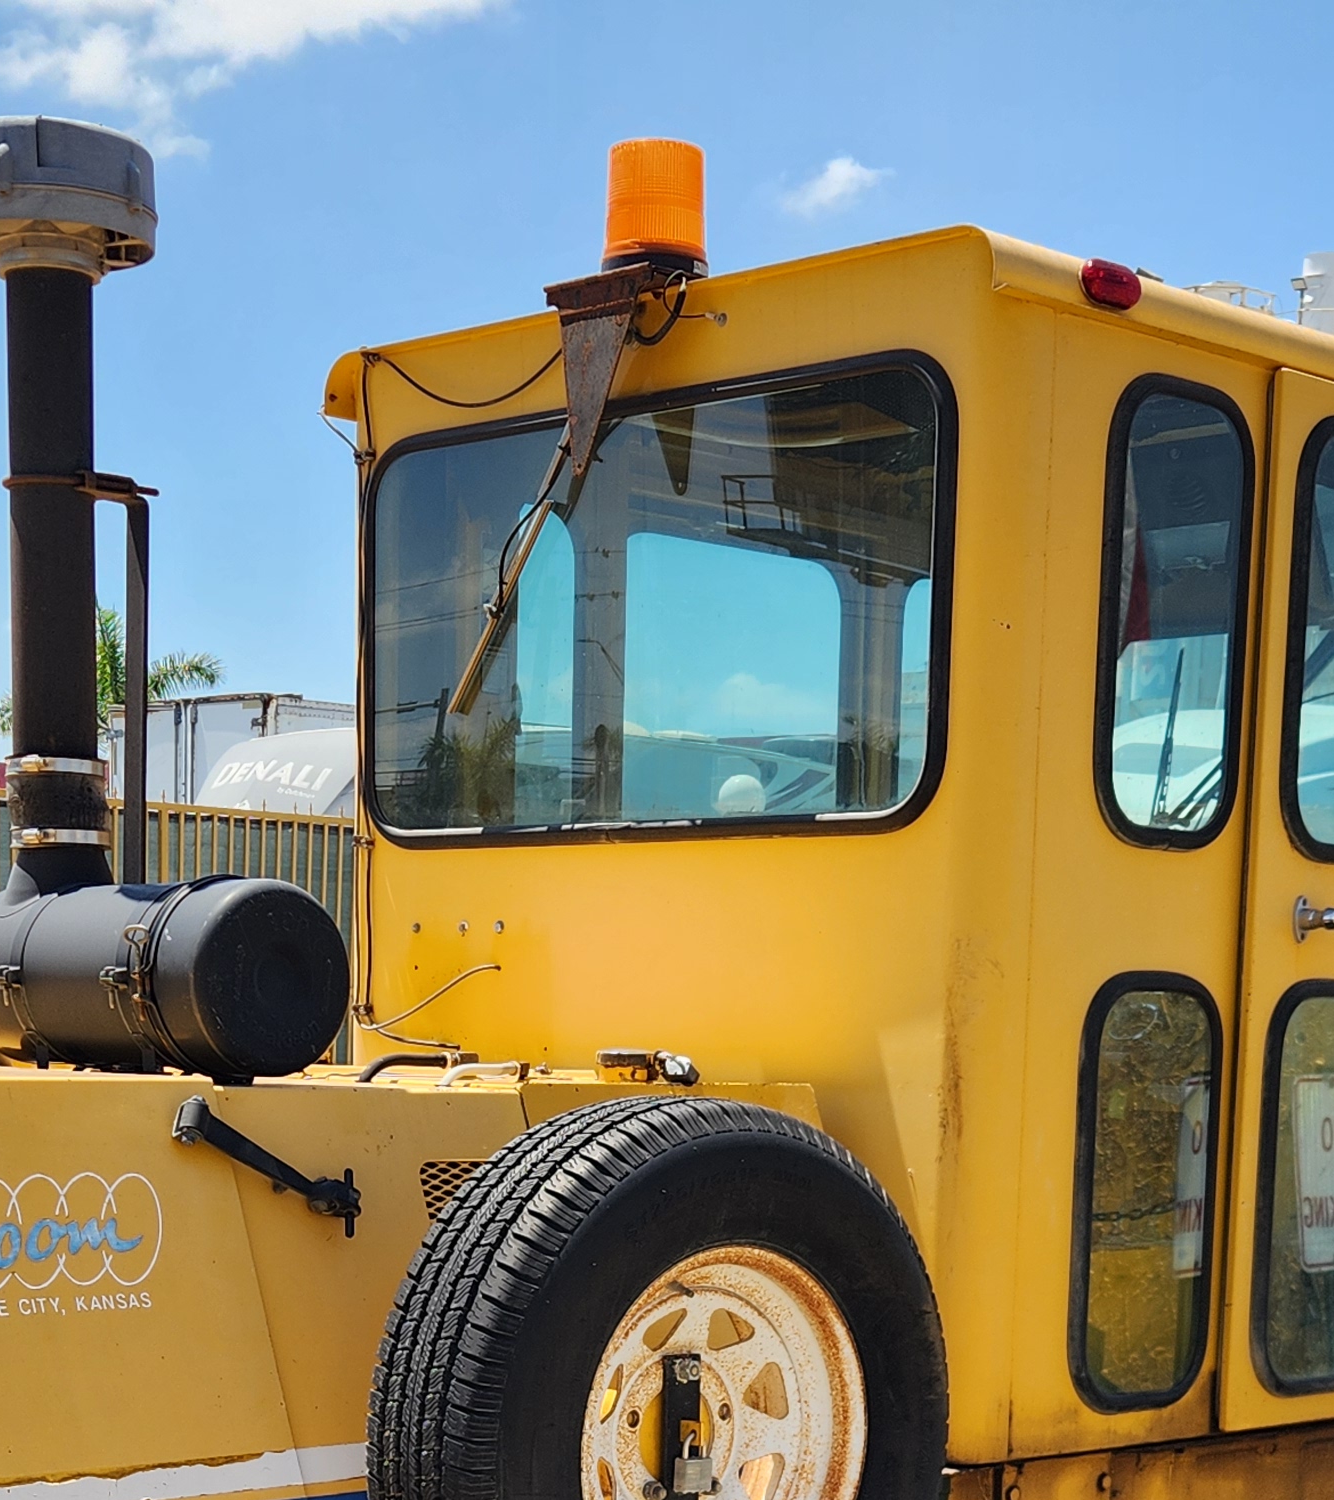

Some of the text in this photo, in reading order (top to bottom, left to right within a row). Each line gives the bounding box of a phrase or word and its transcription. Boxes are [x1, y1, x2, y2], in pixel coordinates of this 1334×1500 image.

[211, 759, 333, 791] DENALI
[18, 1296, 66, 1316] CITY,
[75, 1292, 153, 1312] KANSAS
